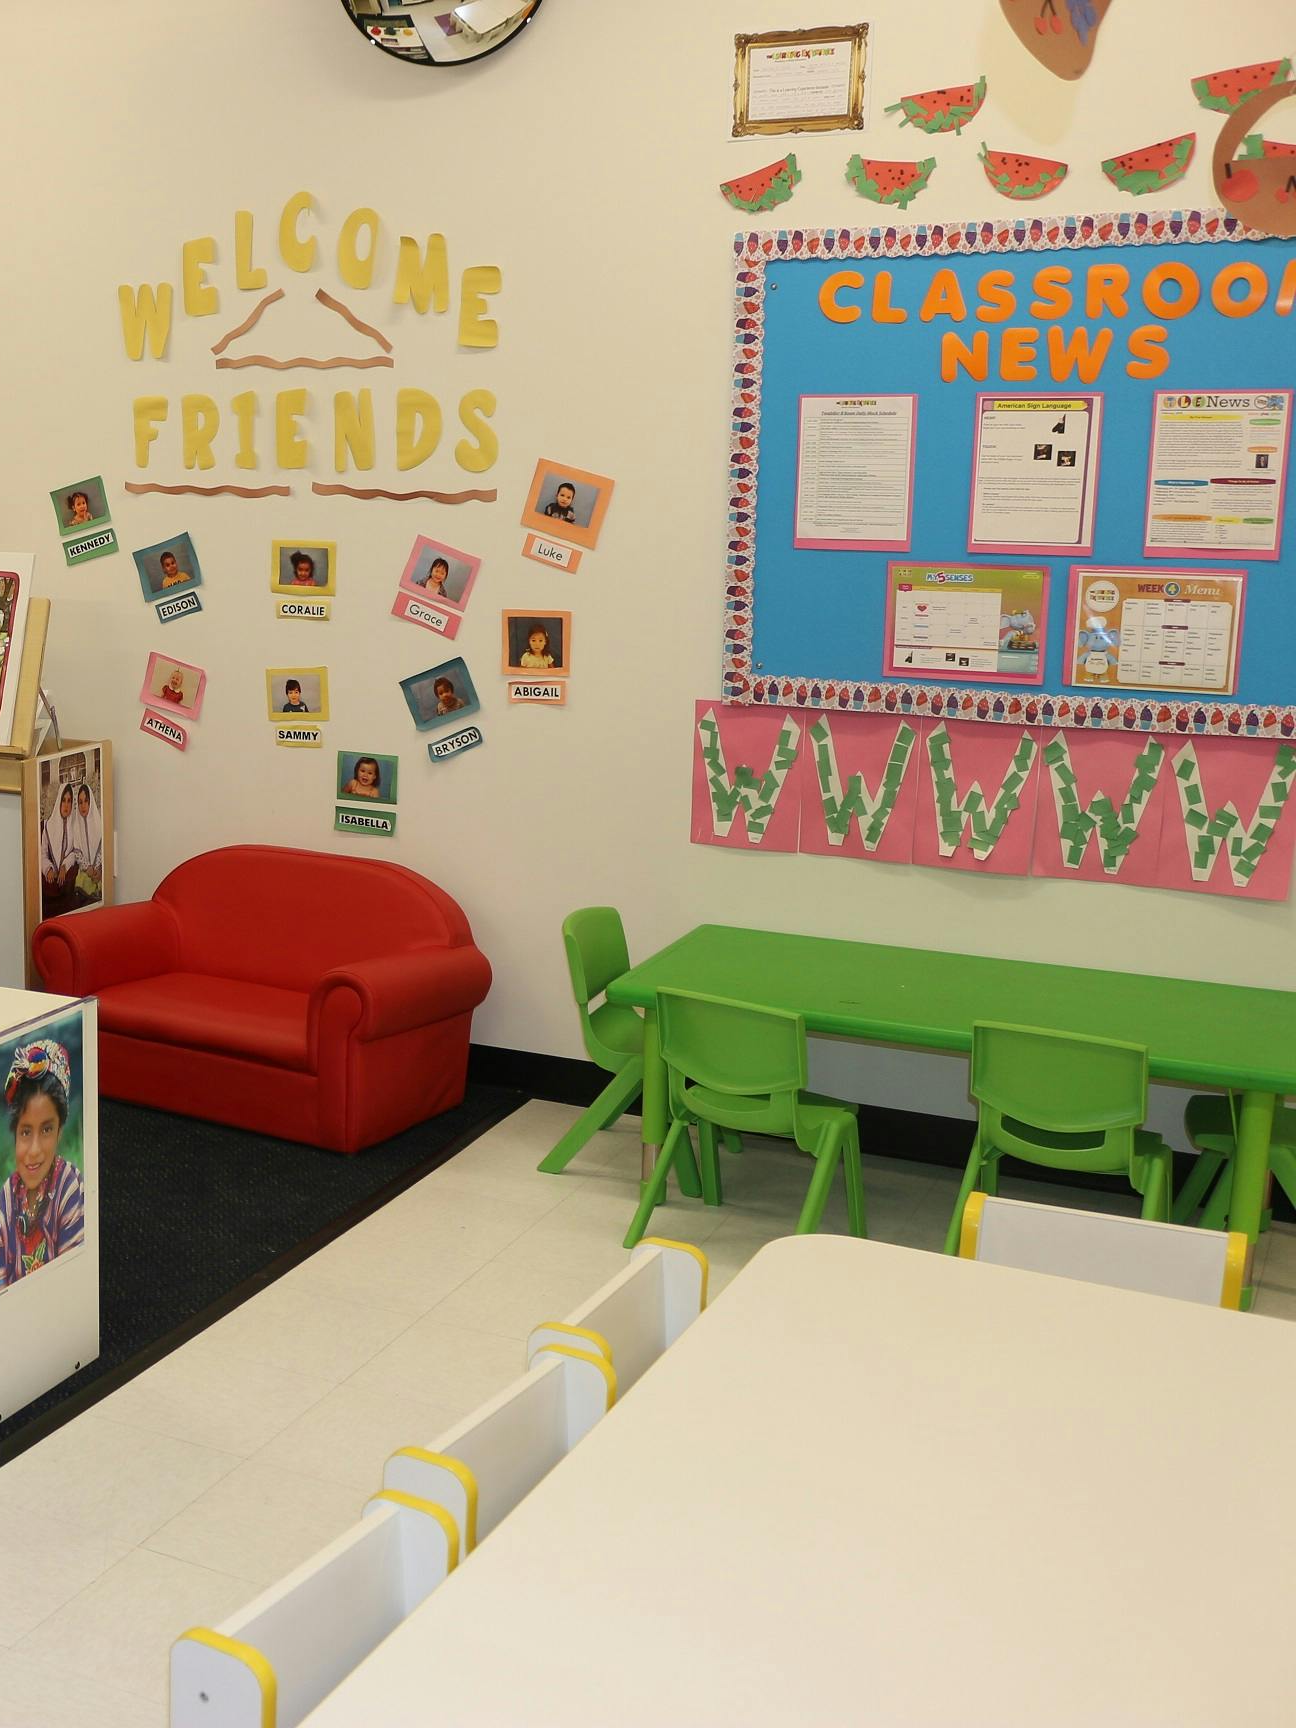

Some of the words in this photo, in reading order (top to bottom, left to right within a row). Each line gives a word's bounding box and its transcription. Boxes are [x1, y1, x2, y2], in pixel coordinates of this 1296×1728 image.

[118, 191, 502, 361] WELCOME
[940, 325, 1171, 384] NEWS
[1207, 395, 1250, 408] News
[133, 388, 498, 473] FRIENDS
[69, 533, 112, 556] KENNEDY
[537, 543, 563, 561] Luke
[937, 572, 945, 583] 5
[945, 574, 973, 582] SENSES
[1137, 583, 1165, 593] WEEK
[1184, 585, 1223, 596] Menu
[161, 597, 197, 618] EDISON
[281, 603, 325, 617] CORALIE
[409, 604, 443, 627] Grace
[514, 686, 560, 698] ABIGAIL
[146, 718, 183, 742] ATHENA
[278, 730, 319, 741] SAMMY
[435, 730, 478, 756] BRYSON
[340, 814, 389, 830] ISABELLA
